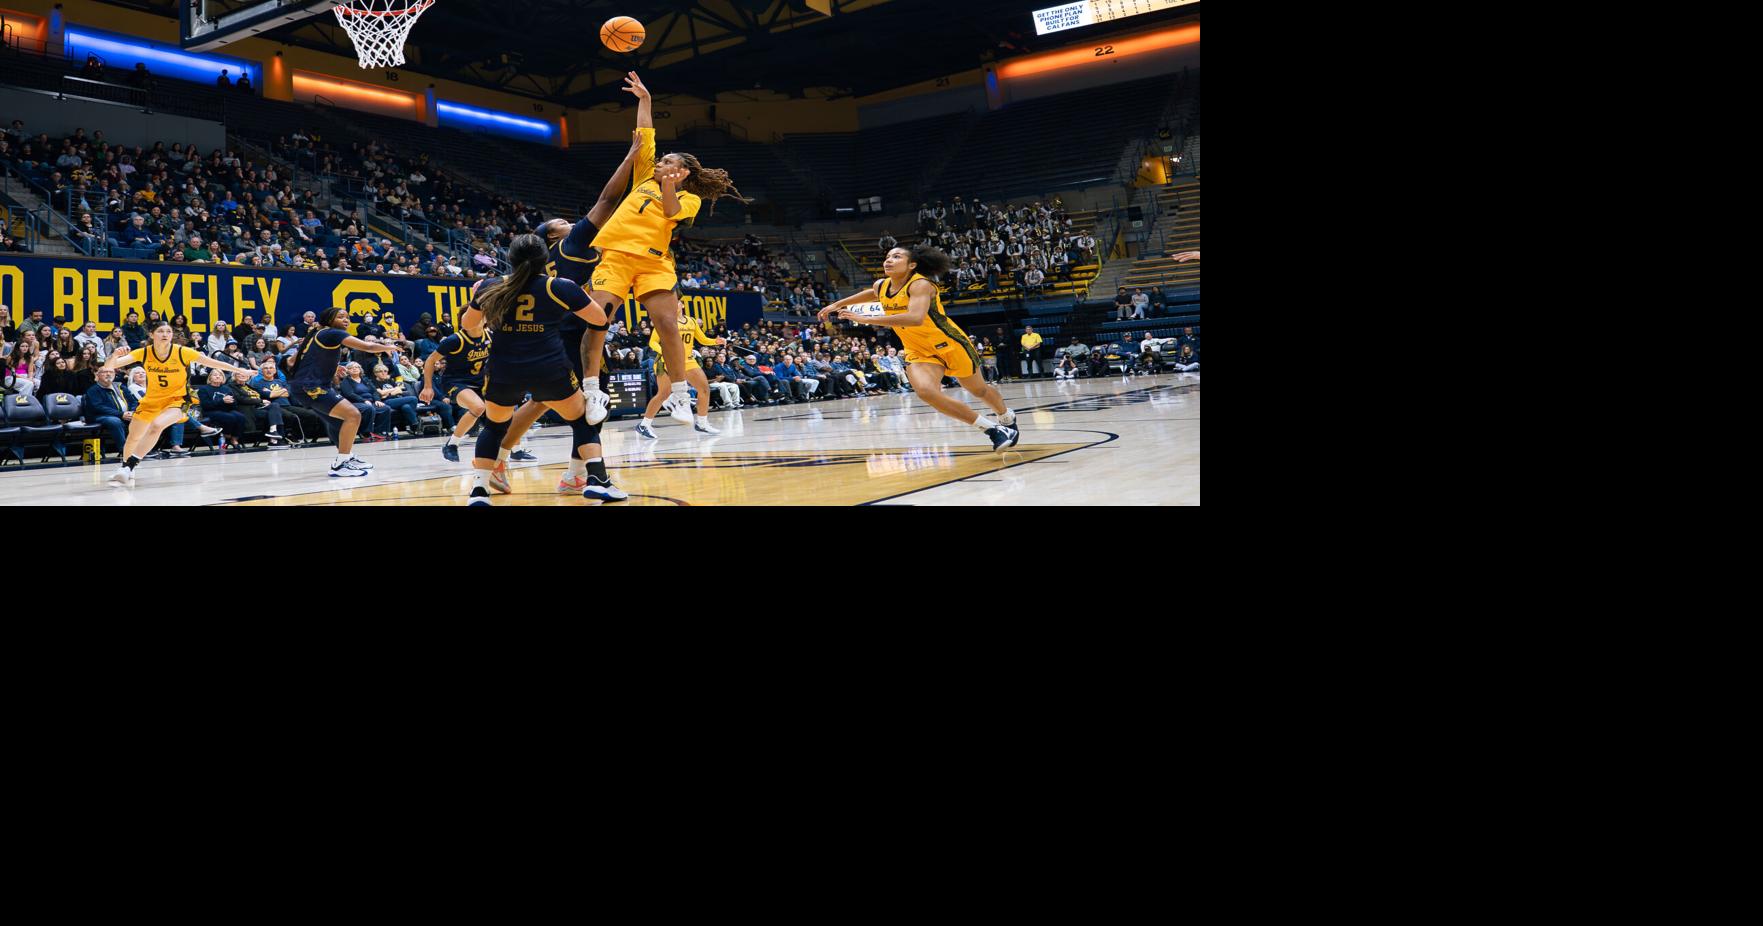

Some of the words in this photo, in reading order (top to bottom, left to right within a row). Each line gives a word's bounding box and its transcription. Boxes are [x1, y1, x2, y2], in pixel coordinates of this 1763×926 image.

[1065, 4, 1083, 12] ONLY
[1040, 14, 1063, 22] PHONE
[1046, 18, 1064, 26] BUILT
[1061, 20, 1080, 28] FANS
[1095, 45, 1114, 56] 22
[385, 70, 399, 81] 18
[639, 199, 652, 214] 1
[545, 261, 557, 277] 5
[53, 267, 281, 332] BERKELEY
[516, 294, 535, 321] 2
[870, 304, 881, 312] 64
[502, 323, 513, 332] de
[516, 323, 545, 333] JESUS
[682, 333, 692, 344] 10
[158, 374, 169, 388] 5
